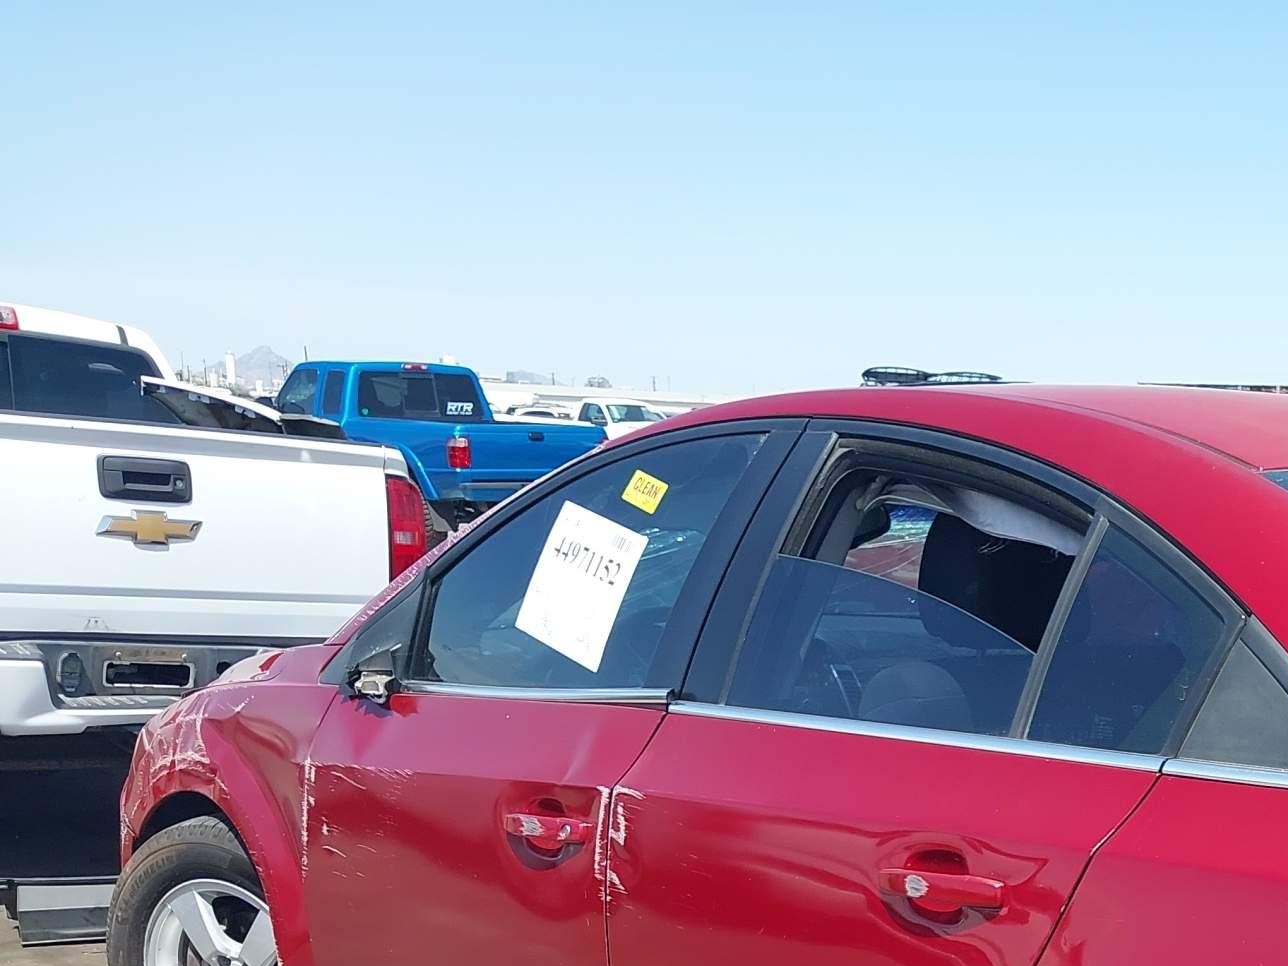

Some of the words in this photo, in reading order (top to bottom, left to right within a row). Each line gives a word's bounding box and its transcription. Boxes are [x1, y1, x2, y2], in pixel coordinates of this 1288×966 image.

[446, 401, 474, 412] RTR
[633, 477, 661, 499] CLEAN
[554, 536, 622, 586] 44971152
